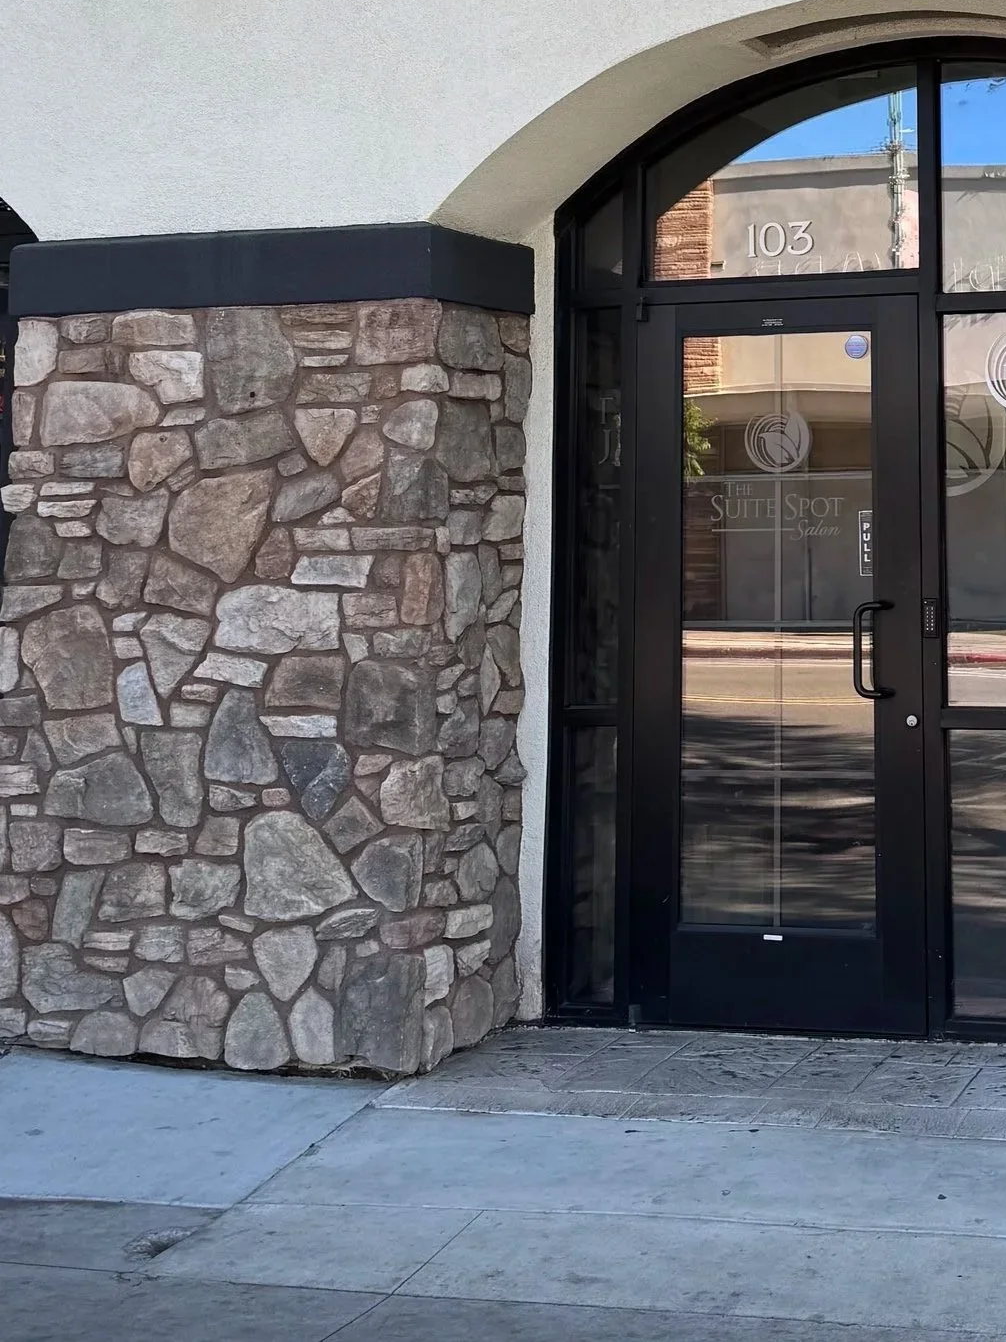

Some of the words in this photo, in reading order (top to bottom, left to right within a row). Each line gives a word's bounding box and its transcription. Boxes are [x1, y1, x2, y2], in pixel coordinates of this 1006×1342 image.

[747, 220, 815, 258] 103
[724, 482, 752, 497] THE
[711, 495, 776, 522] SUITE
[784, 494, 845, 520] SPOT
[790, 520, 841, 541] Salon
[863, 522, 871, 562] PULL
